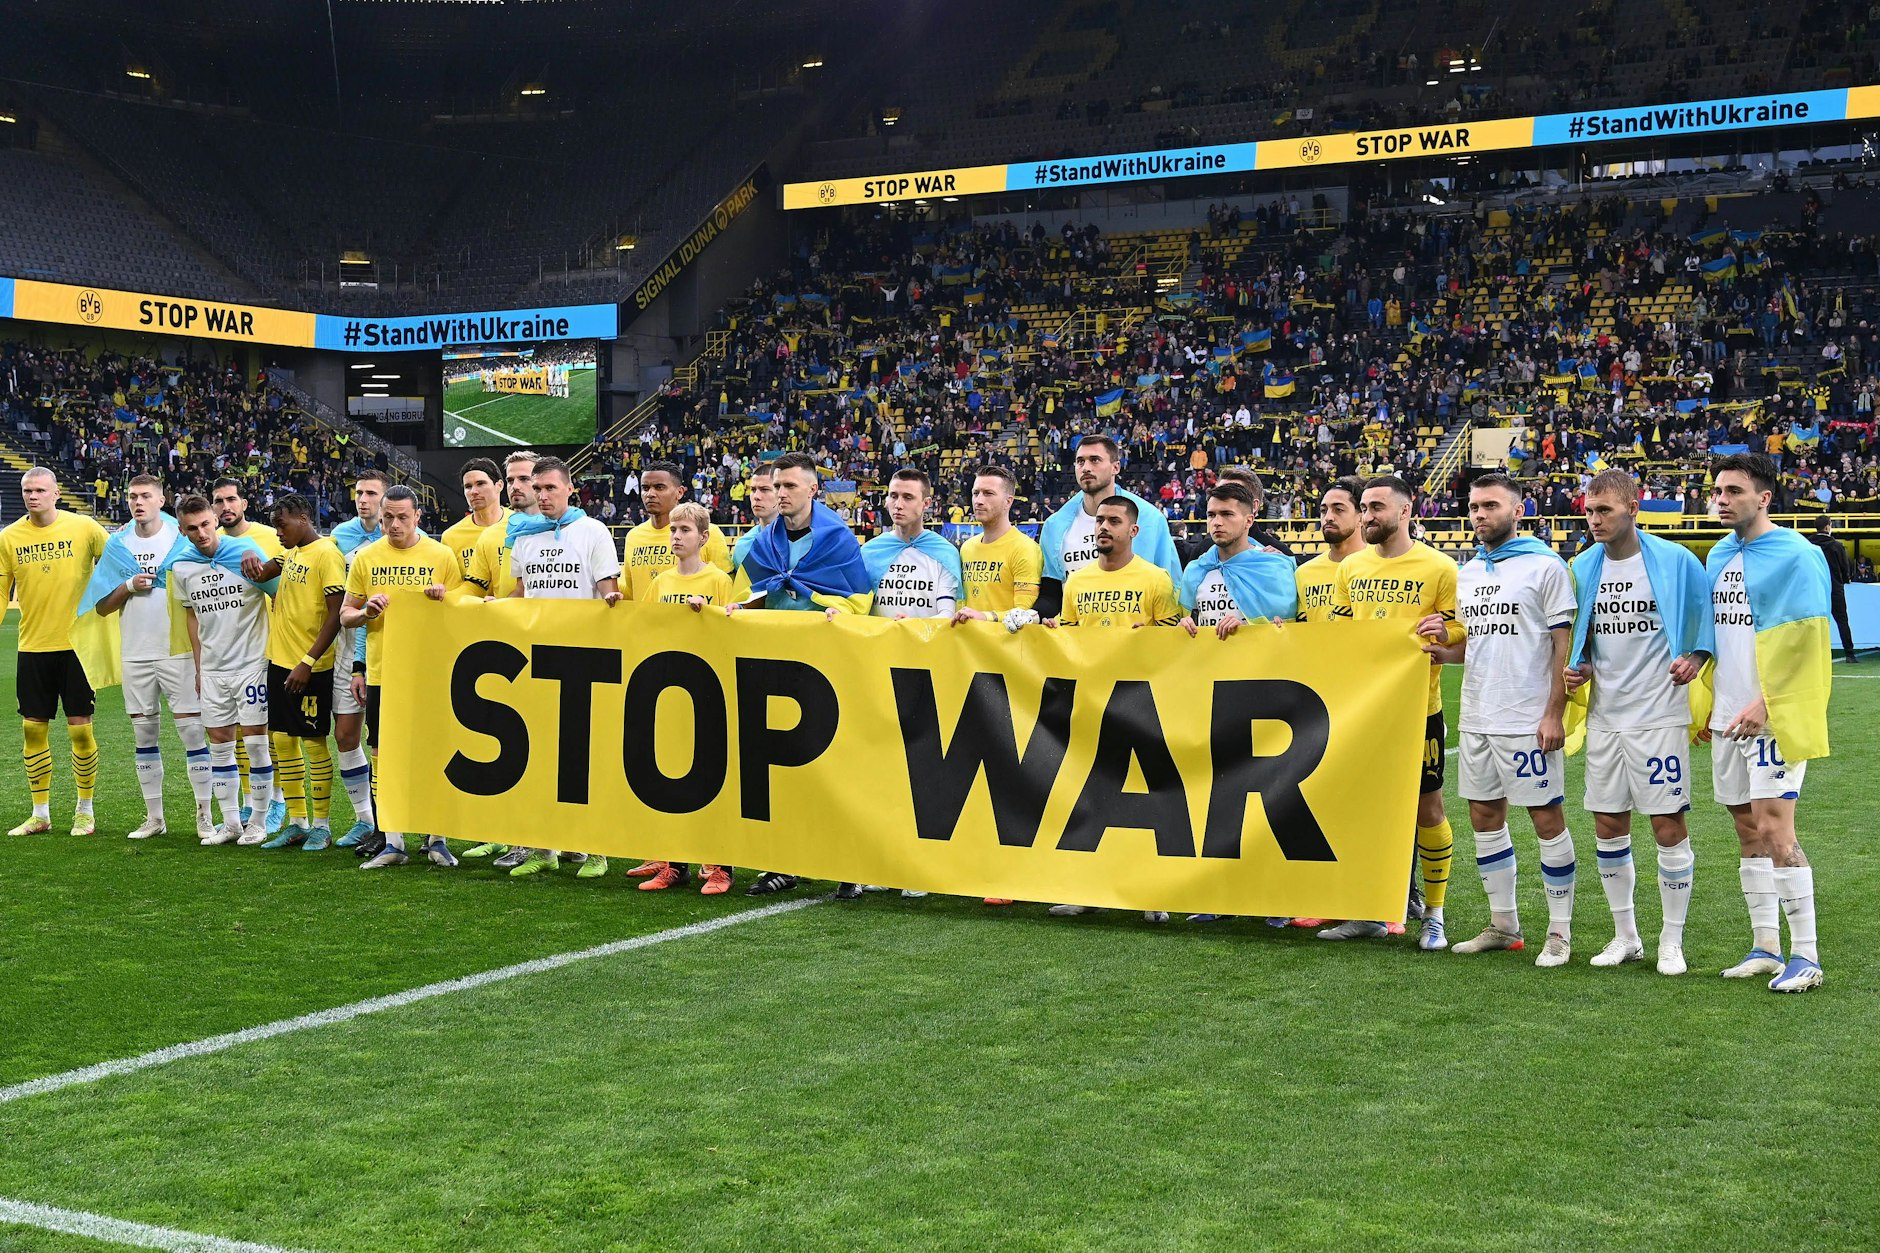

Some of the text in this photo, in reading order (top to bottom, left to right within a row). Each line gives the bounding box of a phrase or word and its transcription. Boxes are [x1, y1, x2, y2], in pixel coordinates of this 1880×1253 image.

[1568, 100, 1809, 138] #StandWithUkraine
[1302, 141, 1320, 157] BVB
[1356, 128, 1470, 156] STOP WAR
[1034, 152, 1226, 184] #StandWithUkraine
[820, 185, 835, 199] BVB
[864, 174, 956, 198] STOP WAR
[635, 178, 759, 310] SIGNAL IDUNA PARK
[80, 292, 101, 314] BVB
[139, 300, 254, 335] STOP WAR
[344, 314, 569, 347] #StandWithUkraine
[500, 377, 542, 390] STOP WAR
[15, 540, 72, 556] UNITED BY
[540, 549, 564, 557] STOP
[633, 546, 667, 556] UNITED
[1064, 548, 1099, 562] GENO
[17, 549, 74, 565] BORUSSIA
[631, 555, 678, 566] BORUSSI
[297, 564, 310, 576] BY
[371, 566, 434, 576] UNITED BY
[526, 563, 580, 574] GENOCIDE
[889, 564, 917, 573] STOP
[989, 562, 1003, 571] BY
[201, 573, 224, 584] STOP
[371, 576, 433, 586] BORUSSIA
[963, 571, 1002, 583] ORUSSIA
[879, 579, 934, 591] ENOCIDE
[1305, 584, 1335, 597] UNIT
[1351, 579, 1424, 592] UNITED BY
[1474, 585, 1501, 597] STOP
[1600, 582, 1633, 593] STOP
[190, 584, 243, 601] GENOCIDE
[1077, 591, 1143, 603] UNITED BY
[1351, 591, 1421, 605] BORUSSIA
[877, 596, 932, 608] ARIUPOL
[1077, 601, 1141, 615] BORUSSIA
[1468, 623, 1519, 638] ARIUPOL
[1593, 620, 1659, 635] ARIUPOL
[245, 684, 267, 705] 99
[301, 696, 318, 717] 43
[445, 640, 1337, 862] STOP WAR
[1513, 749, 1548, 778] 20
[1647, 755, 1682, 785] 29
